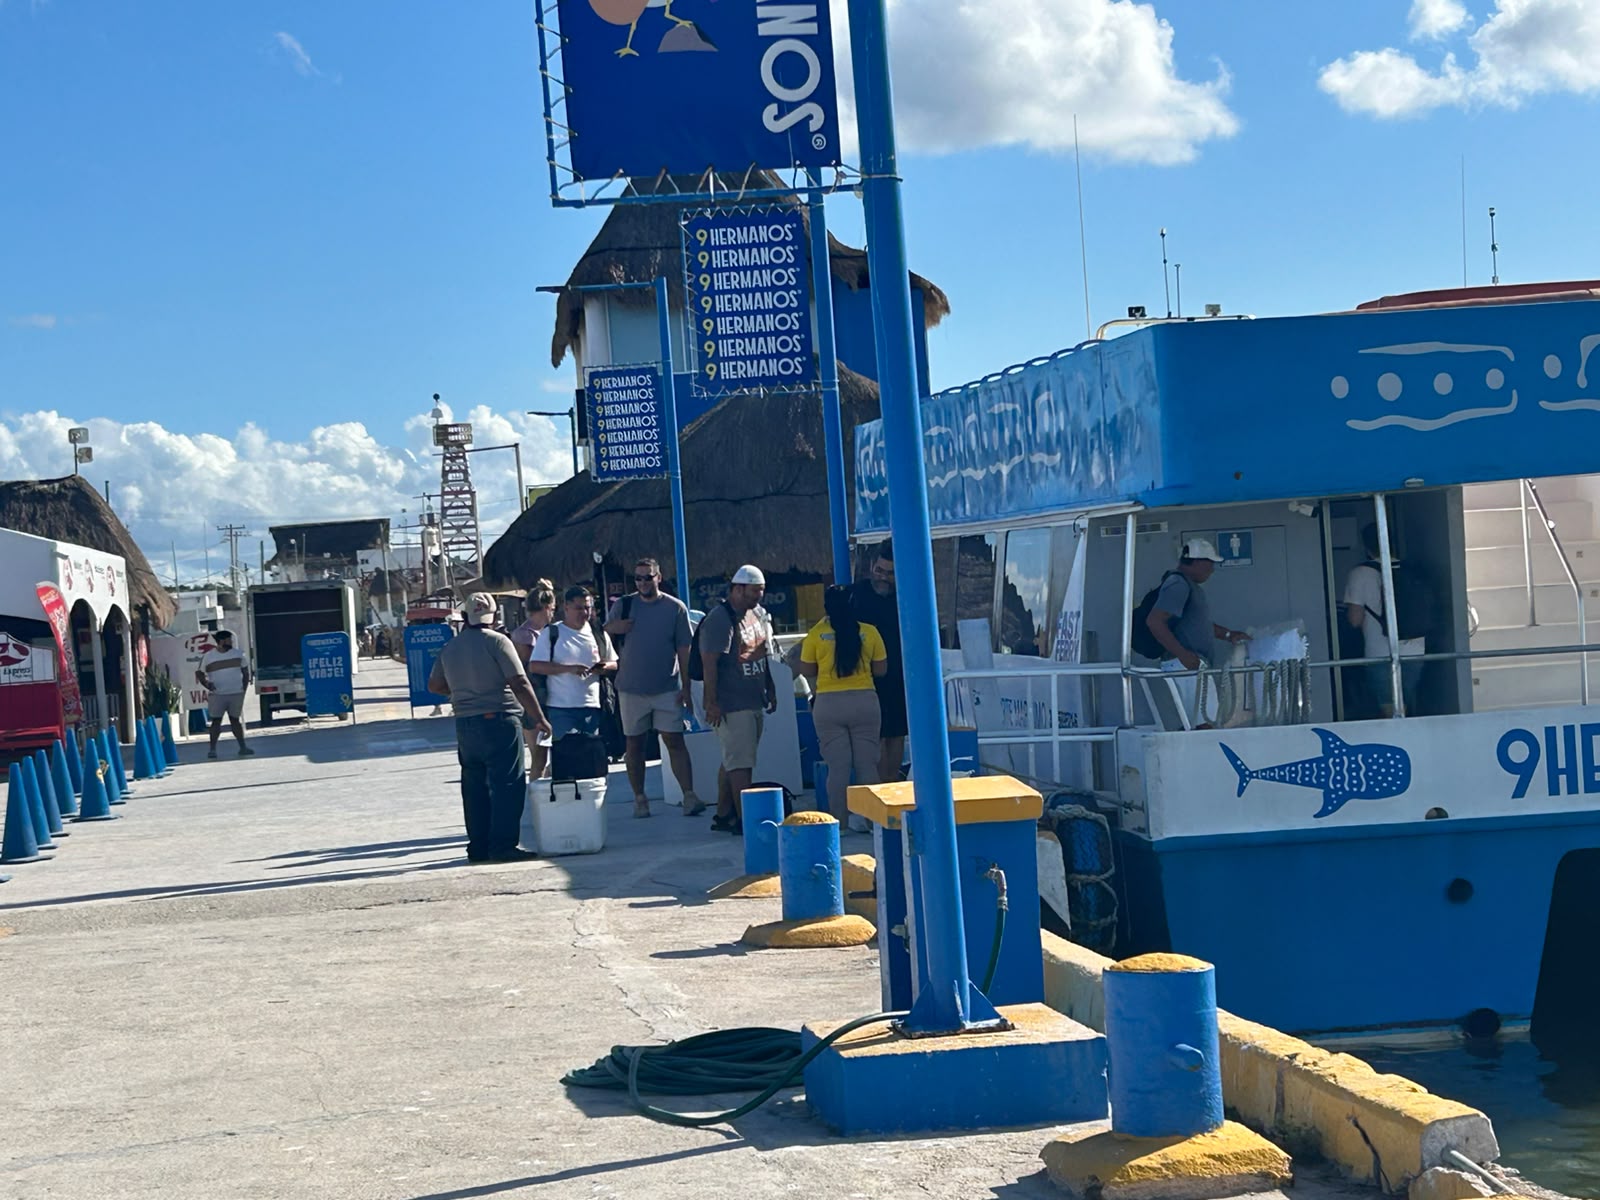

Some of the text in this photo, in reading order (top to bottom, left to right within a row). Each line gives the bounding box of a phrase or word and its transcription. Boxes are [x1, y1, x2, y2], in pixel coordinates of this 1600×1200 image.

[696, 229, 708, 246] 9
[698, 252, 709, 268] 9
[700, 274, 711, 291] 9
[701, 296, 712, 313] 9
[703, 318, 714, 336] 9
[704, 341, 715, 358] 9
[706, 363, 717, 380] 9
[593, 379, 600, 389] 9
[595, 392, 602, 403] 9
[596, 406, 603, 416] 9
[598, 420, 605, 430] 9
[599, 433, 606, 444] 9
[600, 447, 607, 458] 9
[601, 461, 608, 471] 9
[1056, 610, 1081, 639] FAST
[1055, 639, 1080, 662] FERRY
